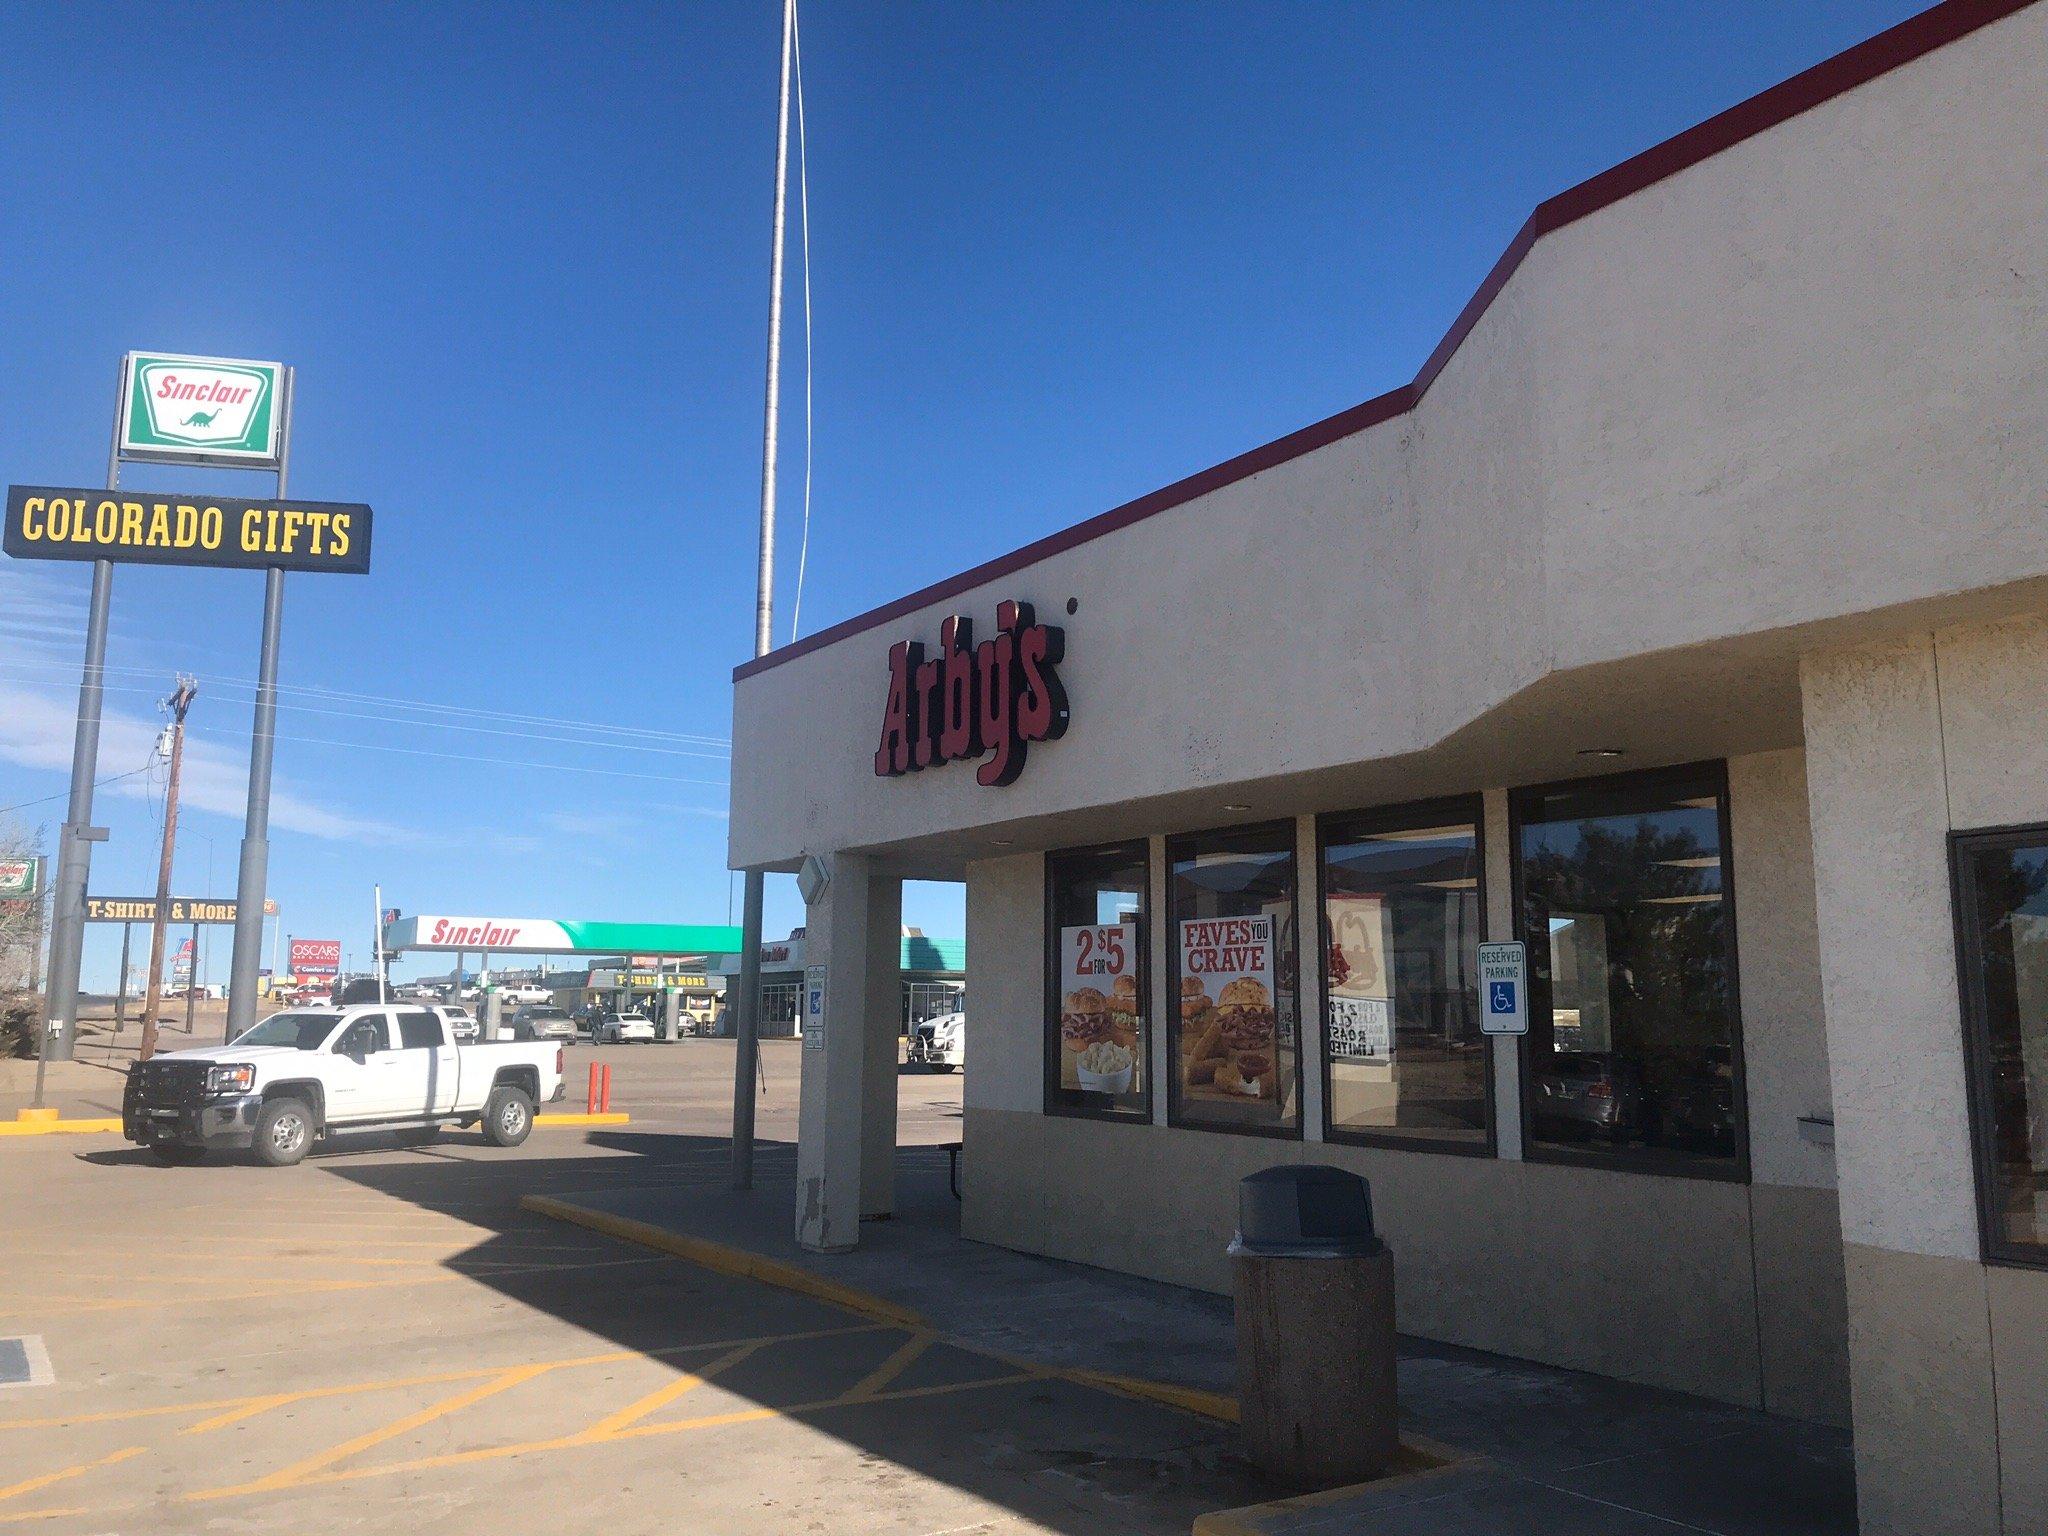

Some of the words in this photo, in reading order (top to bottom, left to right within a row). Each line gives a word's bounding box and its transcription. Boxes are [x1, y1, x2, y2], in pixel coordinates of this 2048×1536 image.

[157, 375, 252, 405] Sinclair
[22, 496, 223, 550] COLORADO
[240, 508, 351, 557] GIFTS
[874, 600, 1063, 788] Arby's
[88, 900, 157, 919] T-SHIRT
[171, 902, 185, 920] &
[189, 903, 237, 920] MORE
[431, 919, 521, 946] Sinclair
[1185, 919, 1251, 948] FAVES
[1251, 922, 1269, 940] YOU
[292, 944, 339, 957] OSCARS
[1076, 929, 1094, 975] 2
[1094, 958, 1106, 974] FOR
[1188, 945, 1265, 974] CRAVE
[1481, 950, 1522, 963] RESERVED
[677, 975, 706, 987] MORE
[1485, 966, 1518, 979] PARKING
